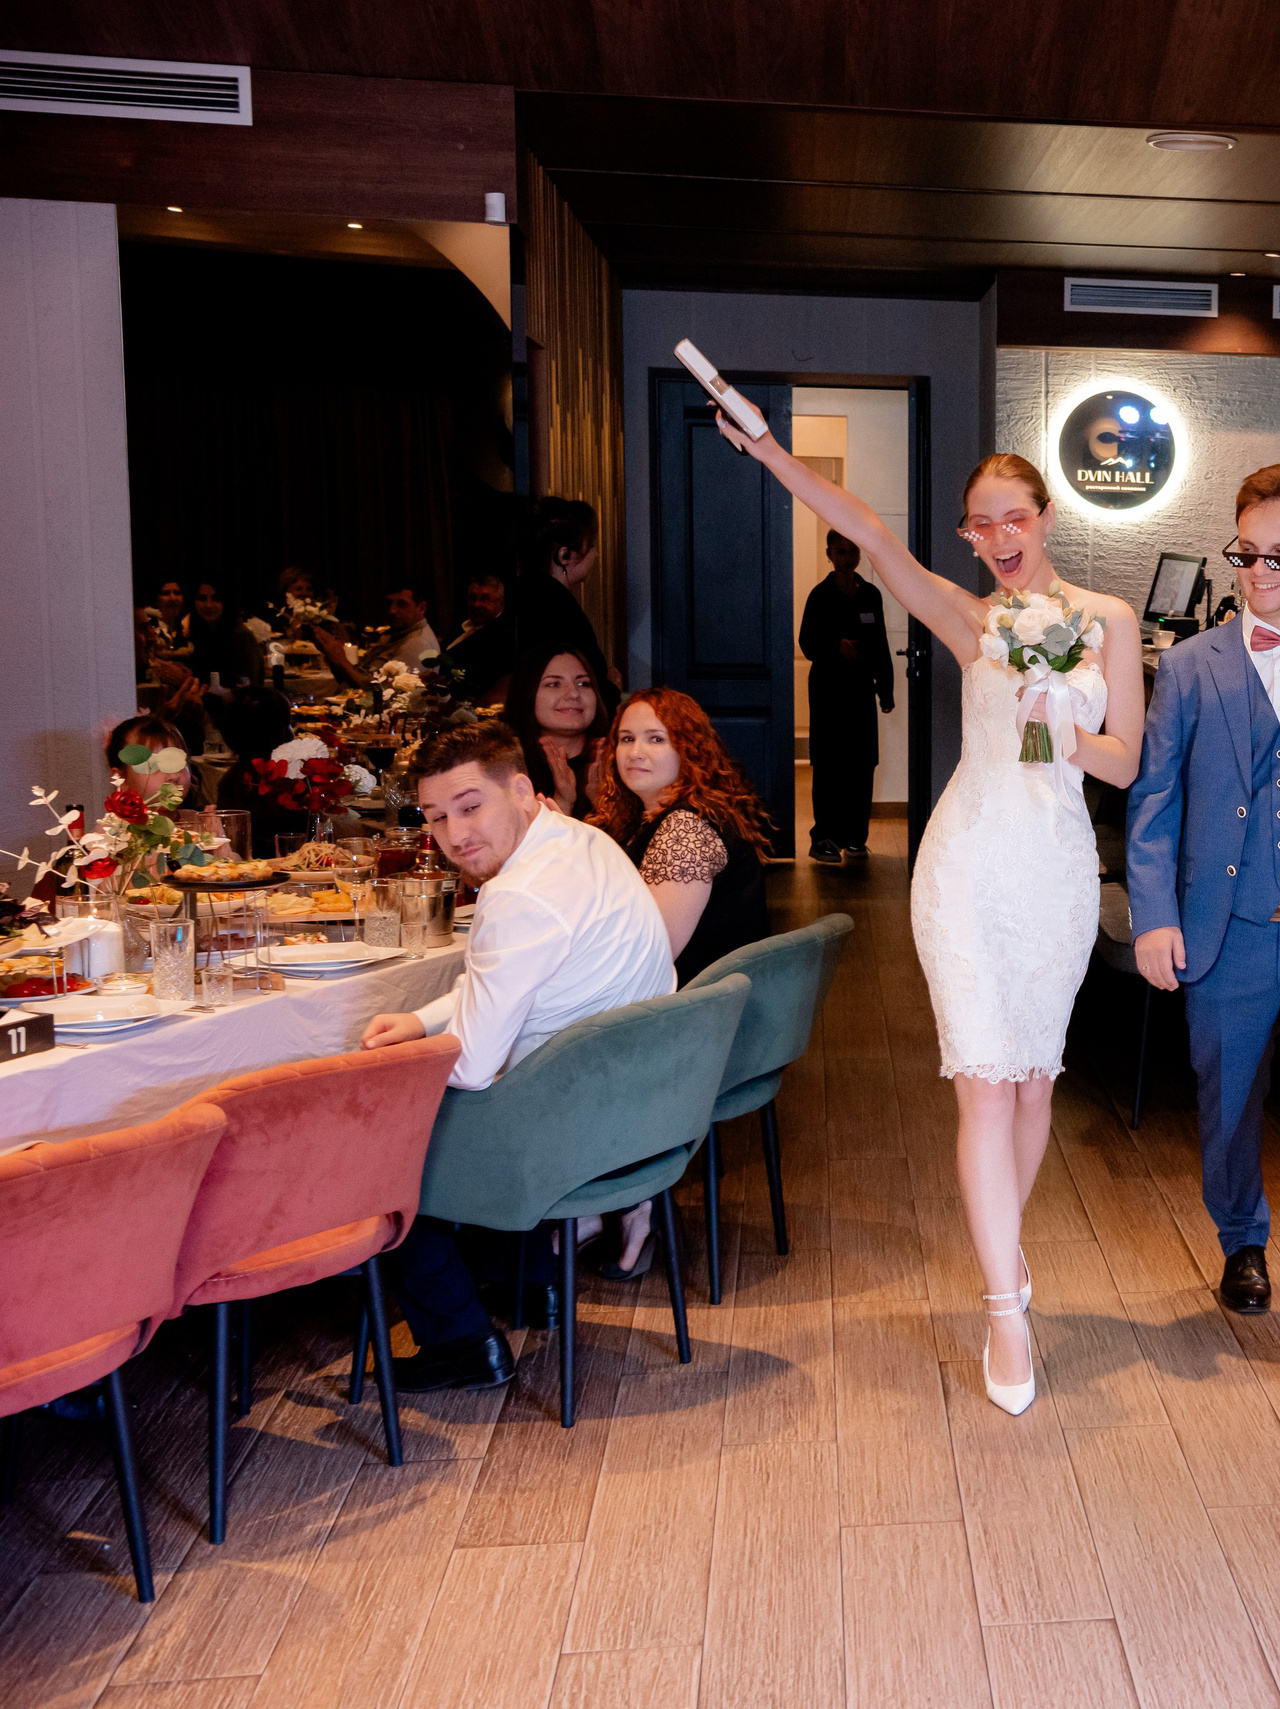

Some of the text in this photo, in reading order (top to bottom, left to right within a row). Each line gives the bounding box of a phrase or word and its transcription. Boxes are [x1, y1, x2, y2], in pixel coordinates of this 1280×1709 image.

[1077, 469, 1155, 484] DVIN HALL
[7, 1026, 27, 1055] 11
